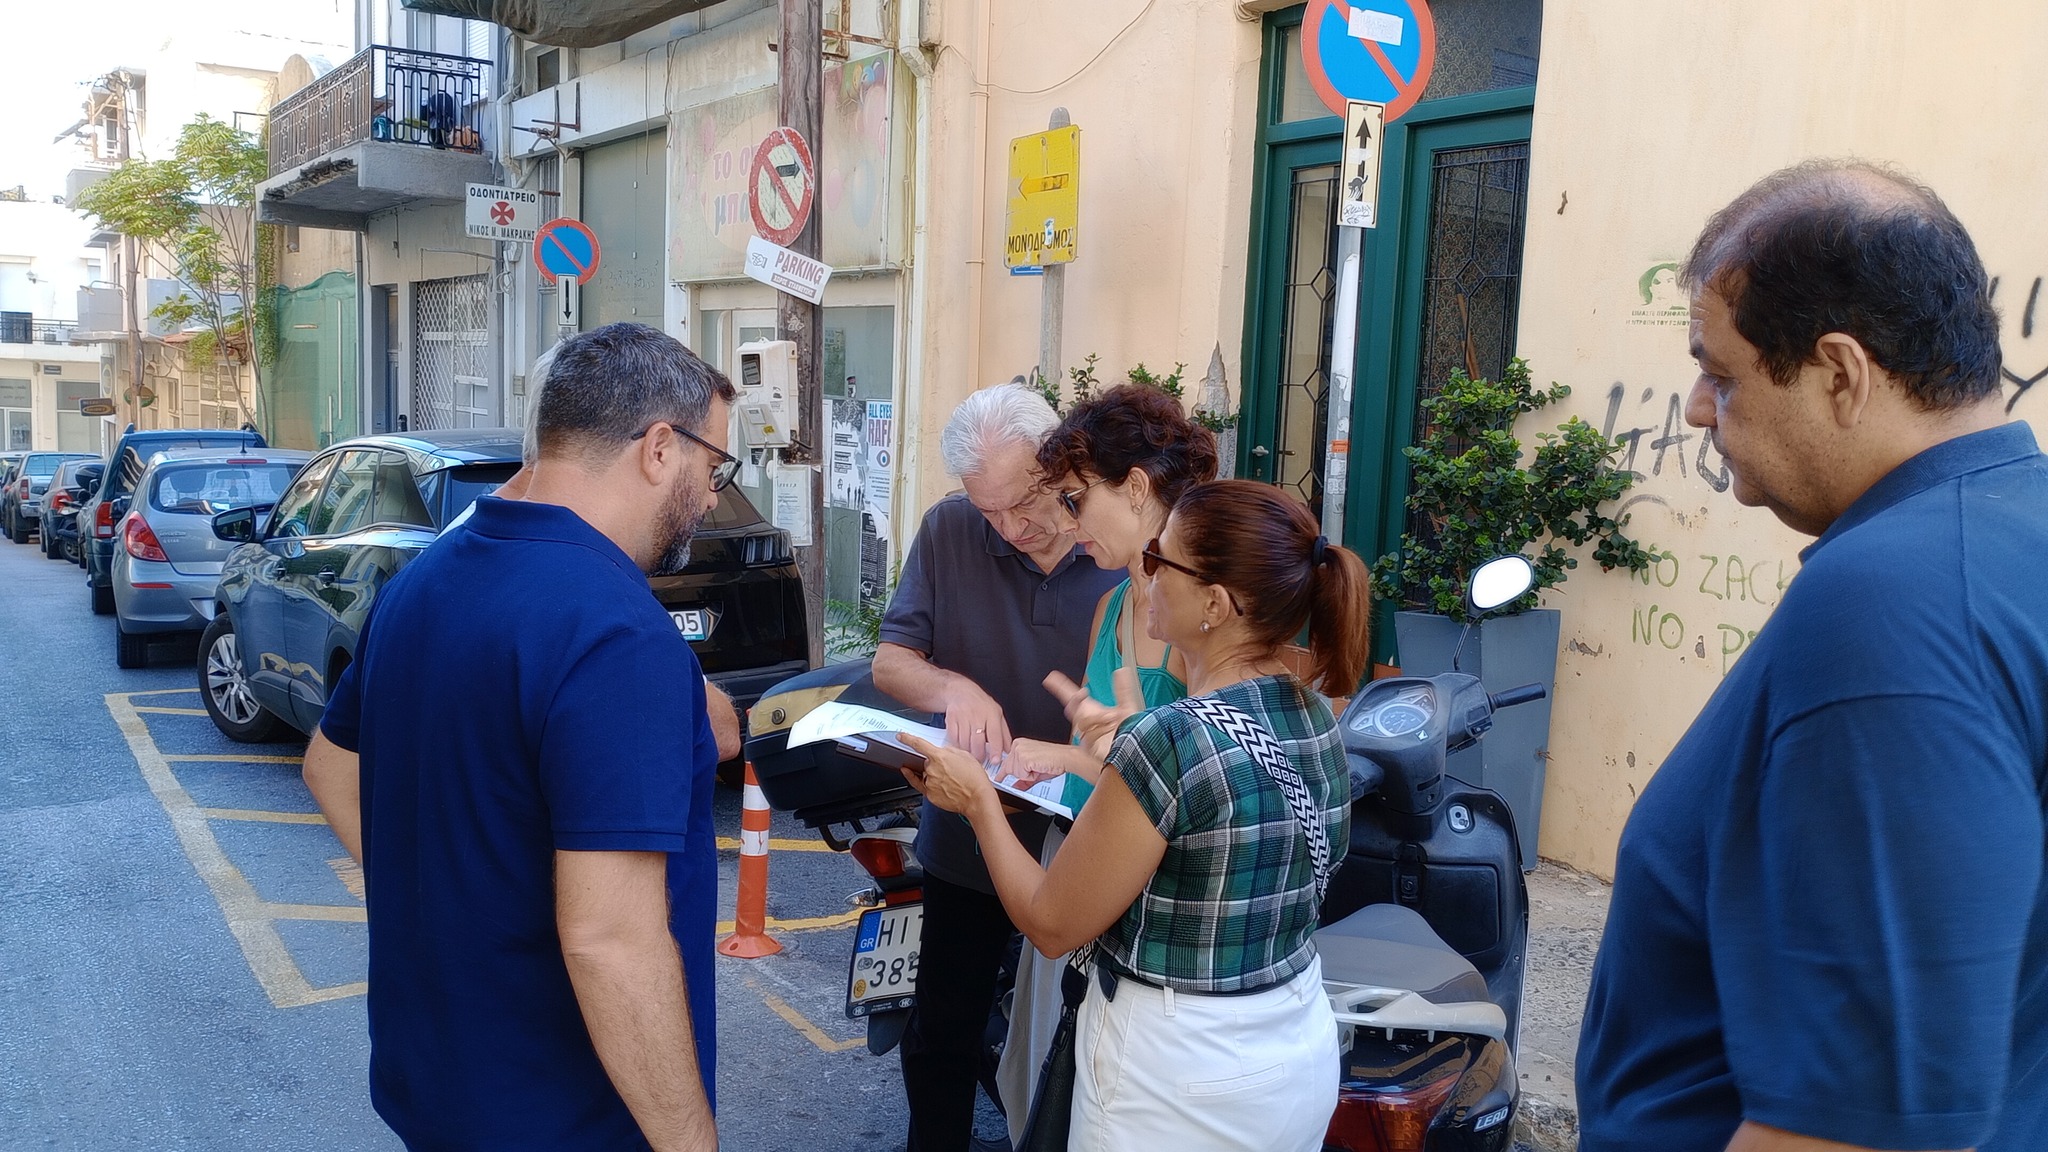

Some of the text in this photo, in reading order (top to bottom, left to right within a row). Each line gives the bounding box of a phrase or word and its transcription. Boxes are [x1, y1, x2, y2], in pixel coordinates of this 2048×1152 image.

[469, 187, 536, 204] ΟΔΟΝΤΙΑΤΡΕΙΟ
[468, 224, 489, 237] ΝΙΚΟΣ
[501, 227, 535, 241] ΜΑΚΡΑΚΗΣ
[775, 250, 824, 285] PARKING
[868, 403, 879, 418] ALL
[673, 612, 699, 632] 05
[1632, 604, 1684, 650] NO
[860, 937, 874, 949] GR
[1474, 1105, 1509, 1132] LEAD
